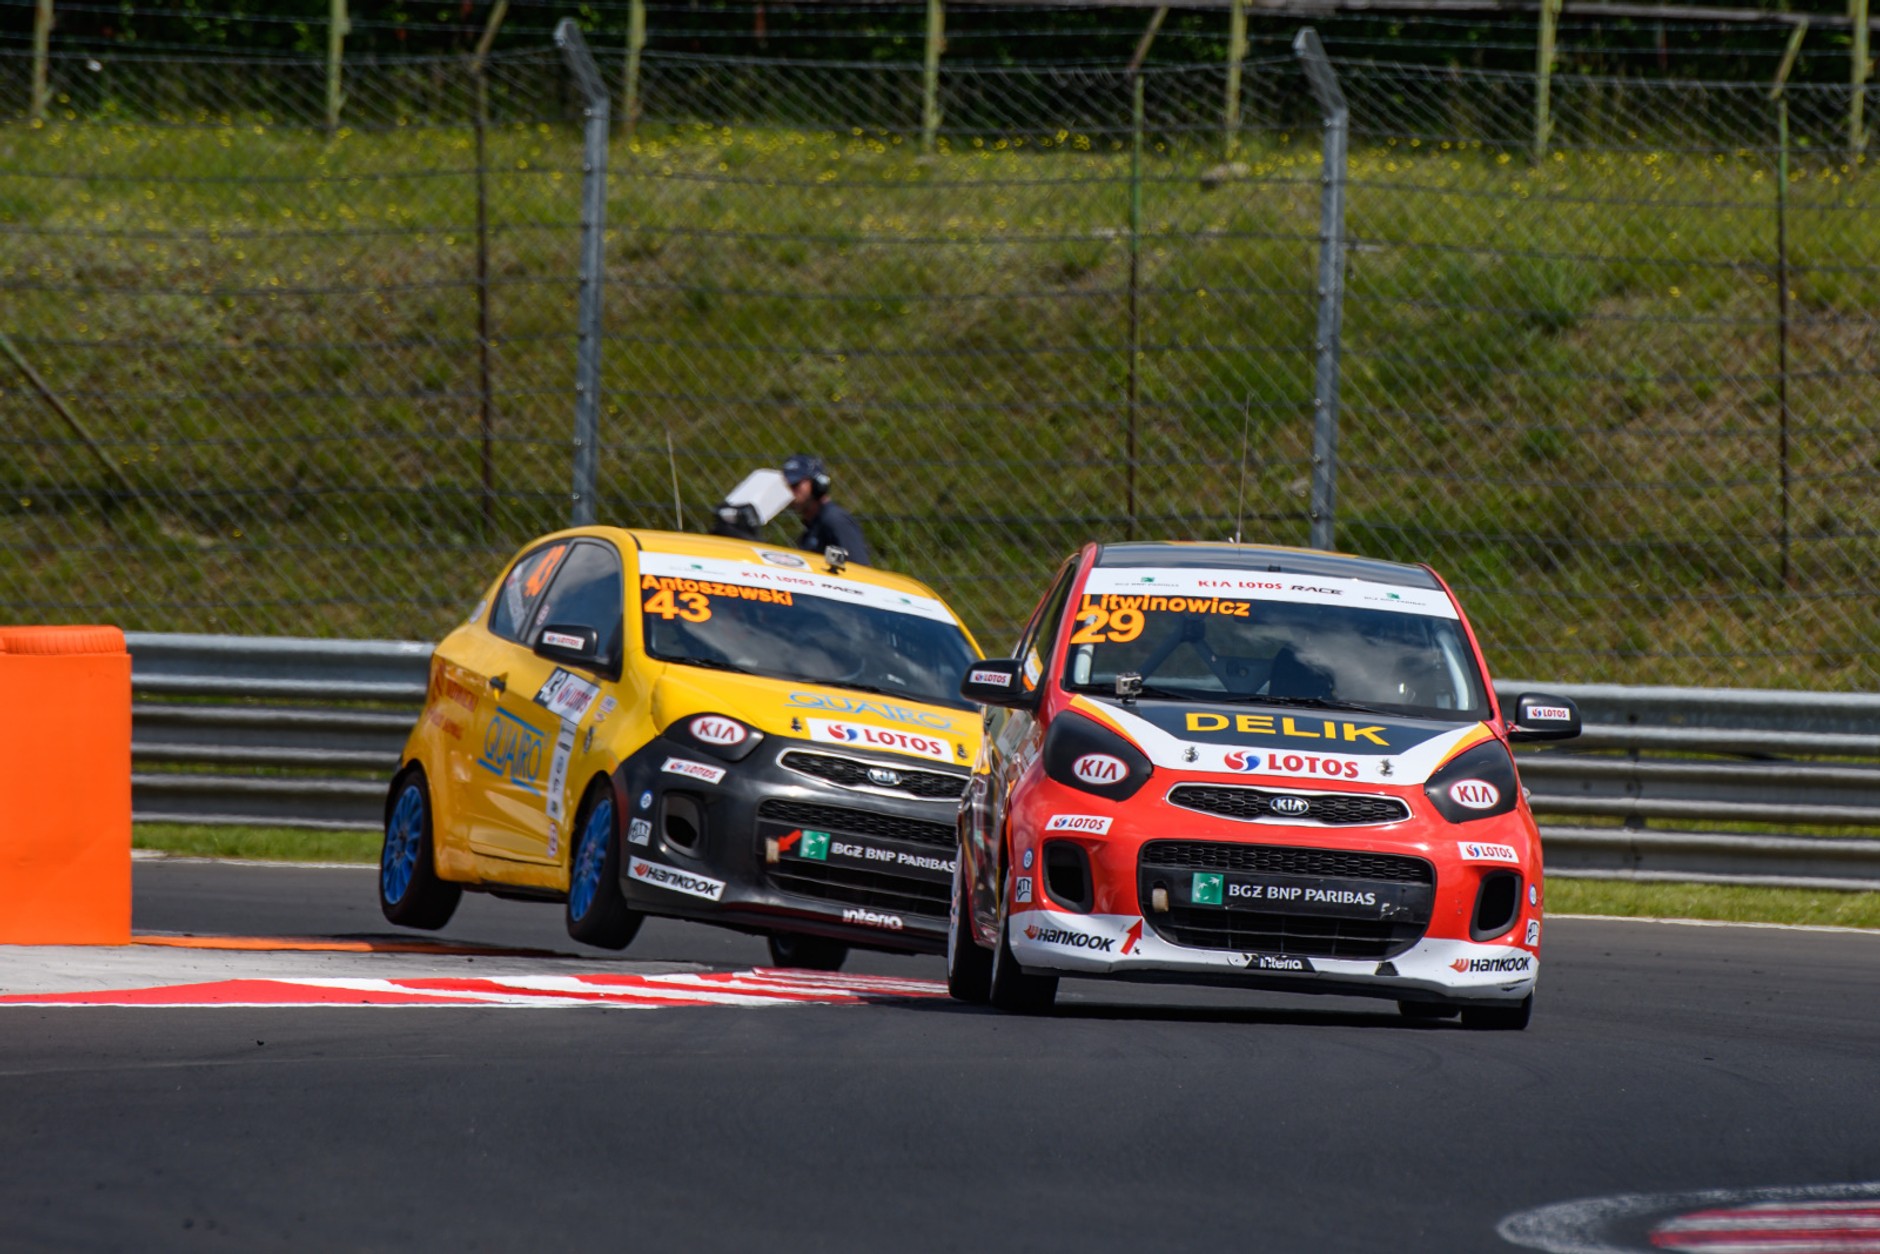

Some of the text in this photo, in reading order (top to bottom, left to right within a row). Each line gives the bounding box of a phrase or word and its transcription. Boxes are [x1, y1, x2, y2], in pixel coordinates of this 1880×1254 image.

[641, 574, 794, 607] Antoszewski
[1198, 580, 1344, 596] KIA LOTOS RACE
[643, 589, 712, 623] 43
[1082, 594, 1251, 617] Litwinowicz
[1070, 608, 1146, 644] 29
[984, 673, 1006, 684] LOTOS
[1543, 709, 1567, 718] LOTOS
[699, 720, 735, 741] KIA
[1185, 712, 1391, 747] DELIK
[864, 728, 942, 755] LOTOS
[683, 765, 718, 779] LOTOS
[1080, 759, 1117, 780] KIA
[1267, 753, 1359, 779] LOTOS
[1276, 799, 1304, 811] KIA
[1456, 785, 1494, 804] KIA
[1068, 818, 1106, 831] LOTOS
[865, 847, 897, 862] BNP
[897, 853, 957, 873] PARIBAS
[1480, 845, 1513, 859] LOTOS
[1267, 886, 1302, 901] BNP
[1305, 889, 1377, 906] PARIBAS
